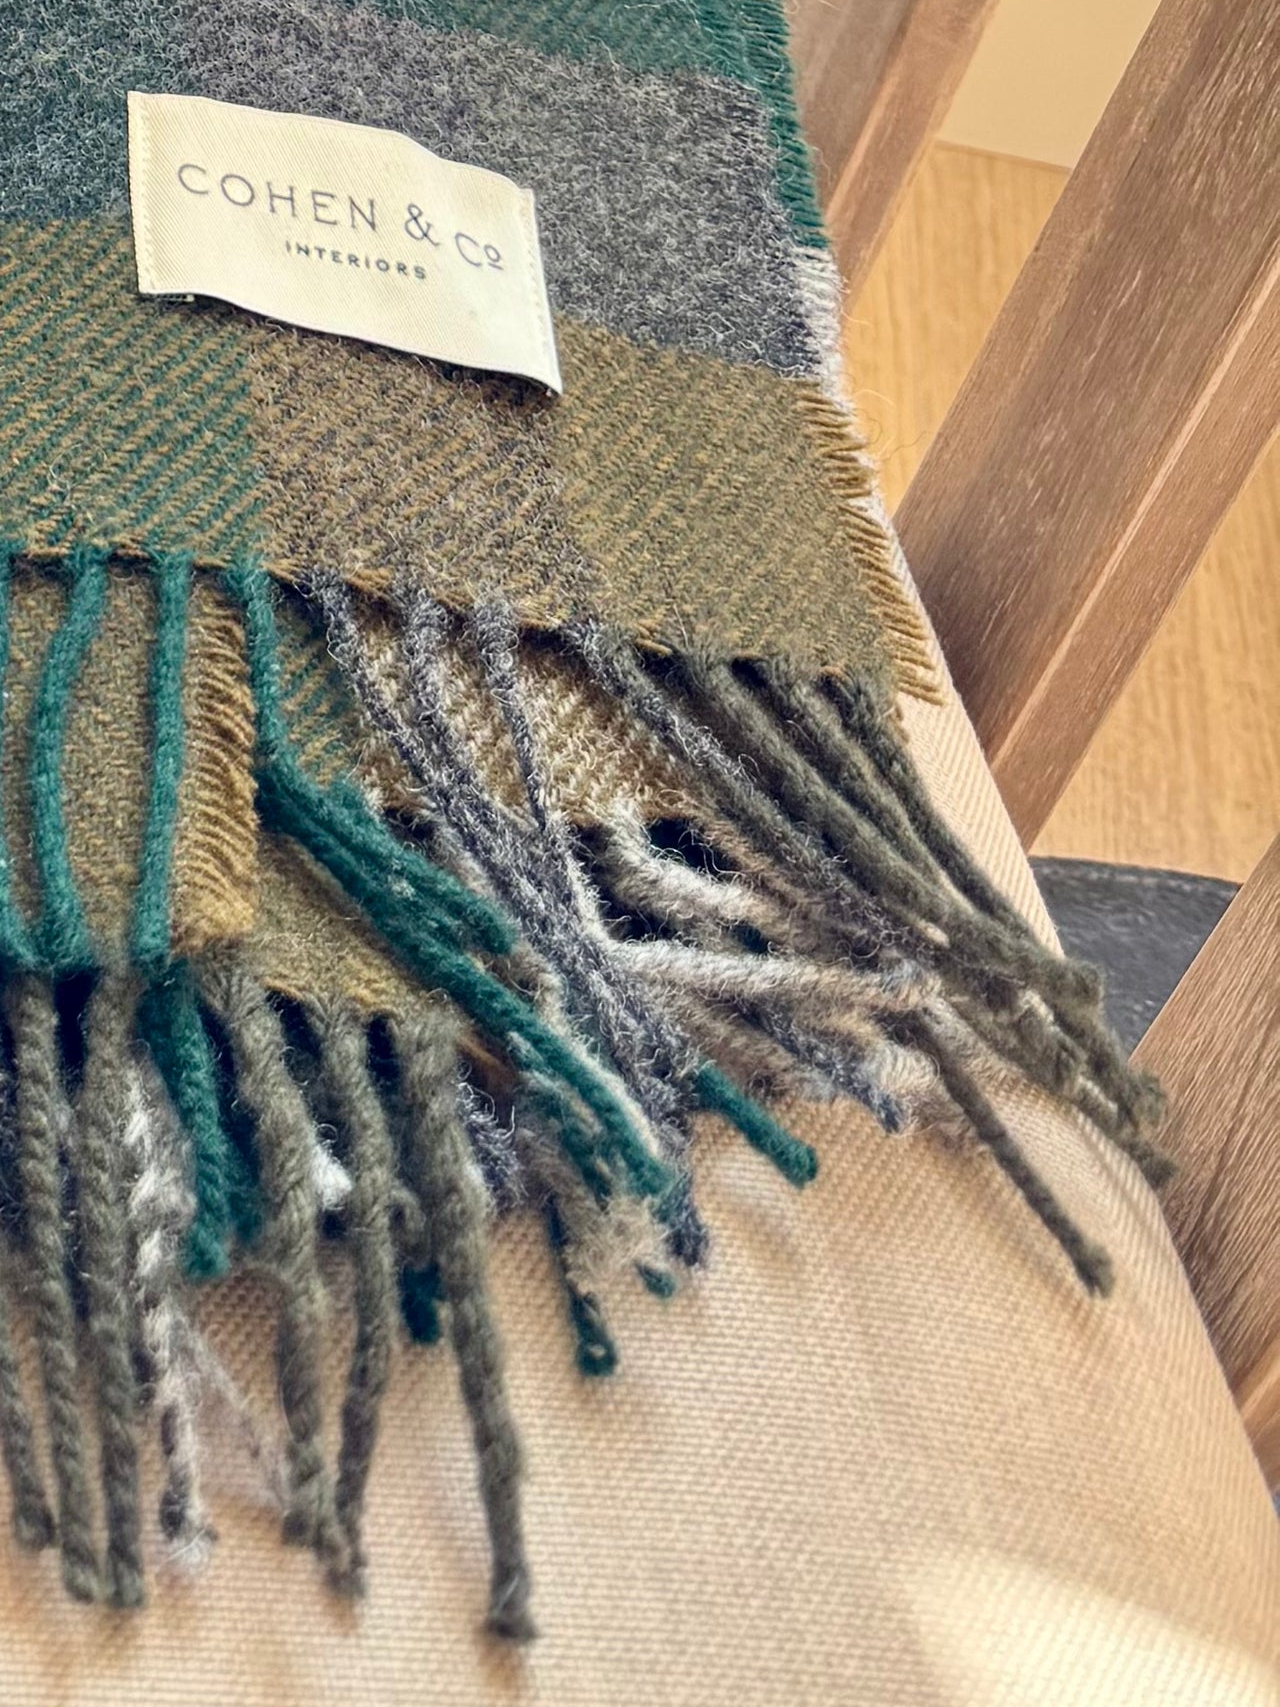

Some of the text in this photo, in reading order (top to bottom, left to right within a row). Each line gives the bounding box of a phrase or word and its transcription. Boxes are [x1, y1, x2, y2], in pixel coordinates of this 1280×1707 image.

[177, 163, 377, 232] COHEN
[404, 203, 440, 247] &
[285, 240, 427, 280] INTERIORS
